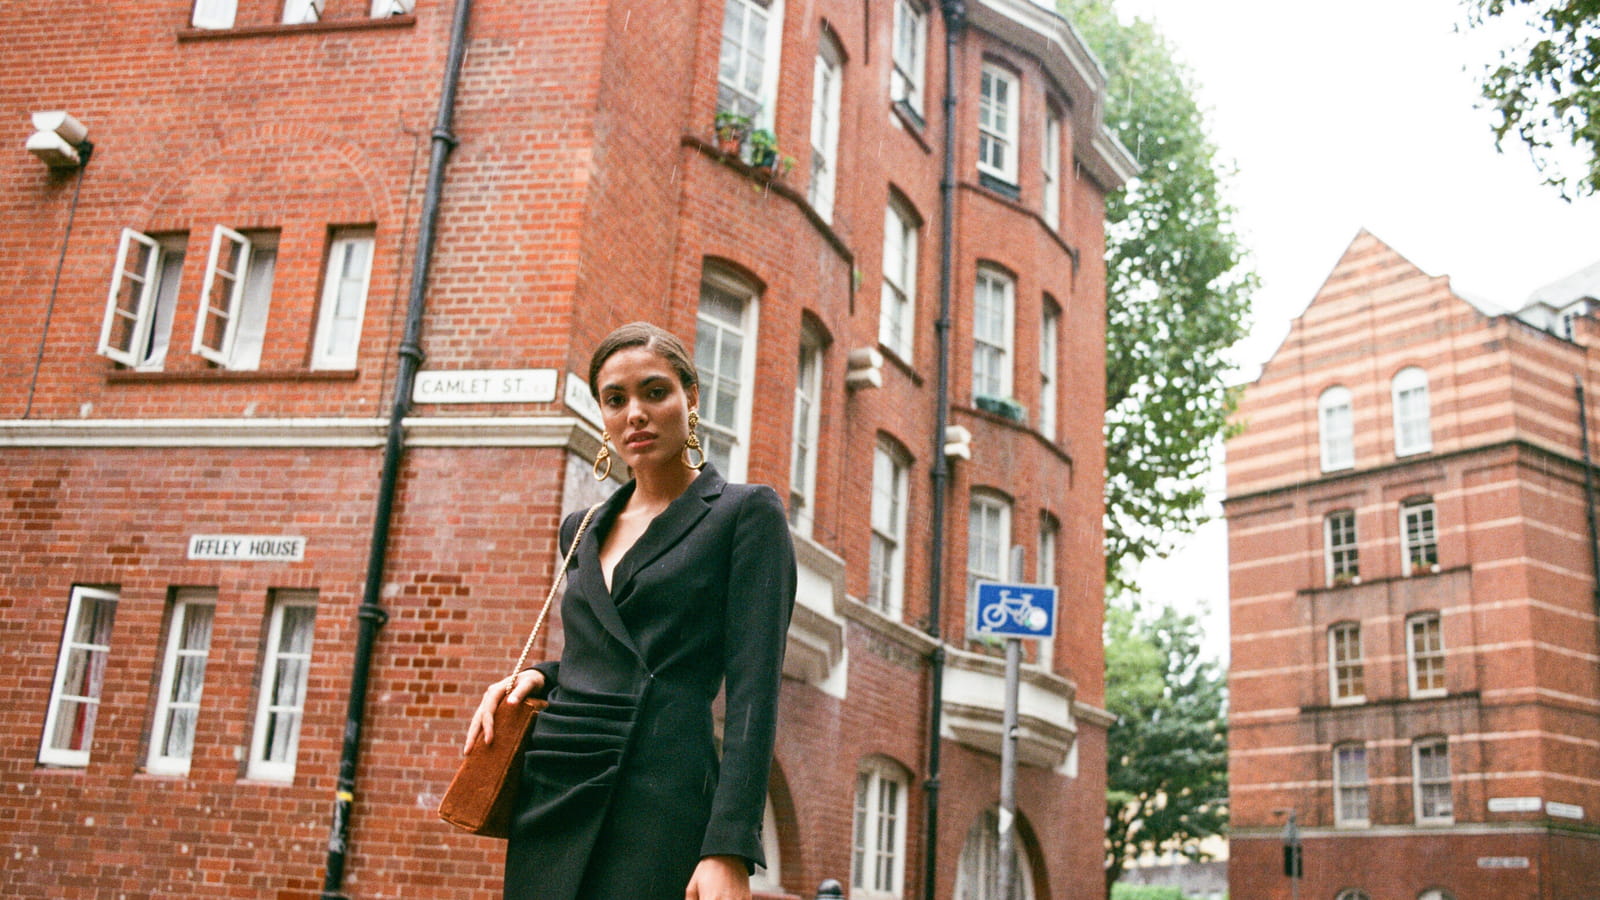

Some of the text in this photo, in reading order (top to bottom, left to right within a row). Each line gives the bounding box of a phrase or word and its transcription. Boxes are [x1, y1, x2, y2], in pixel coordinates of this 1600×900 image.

[421, 378, 490, 394] CAMLET
[194, 539, 300, 557] IFFLEY HOUSE
